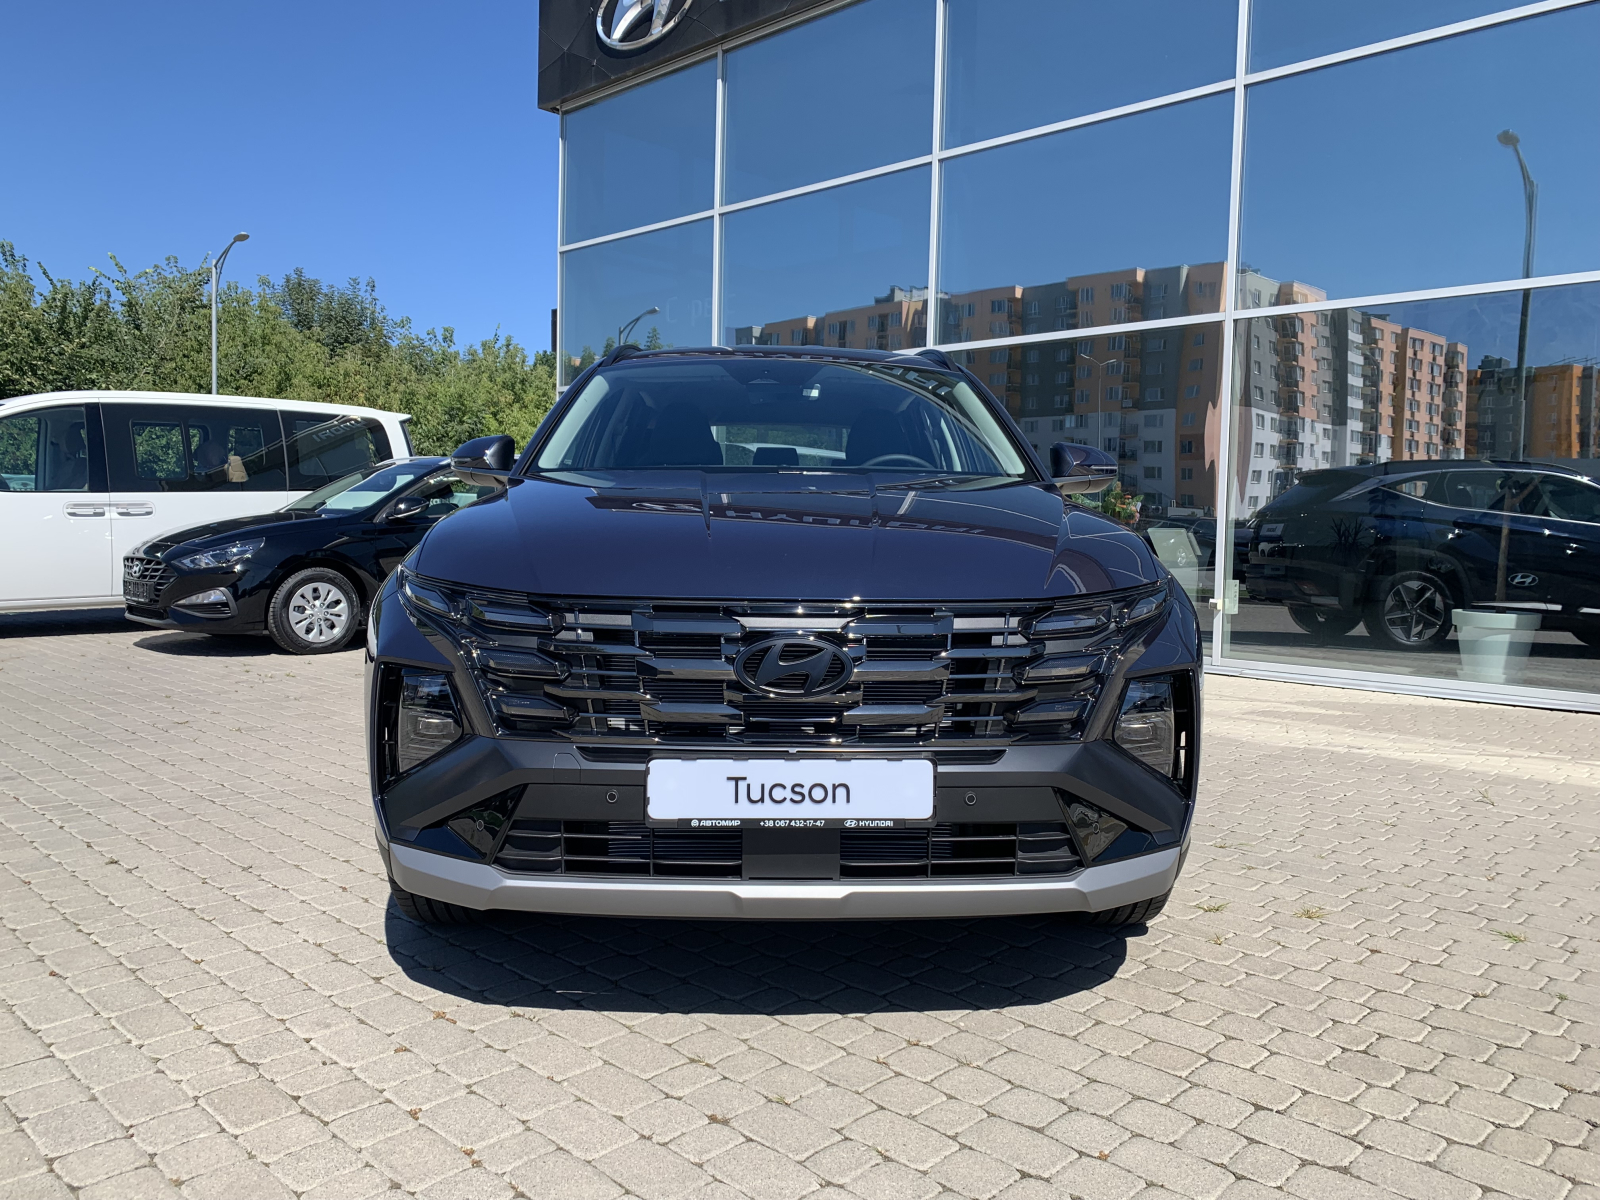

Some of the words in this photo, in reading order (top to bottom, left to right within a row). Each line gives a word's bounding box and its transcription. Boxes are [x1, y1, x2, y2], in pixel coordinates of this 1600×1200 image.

[726, 776, 851, 805] Tucson
[699, 819, 741, 828] АВТОМИР
[759, 819, 774, 828] +38
[774, 819, 790, 828] 067
[789, 819, 825, 828] 432-17-47
[858, 819, 894, 828] HYUNDAI
